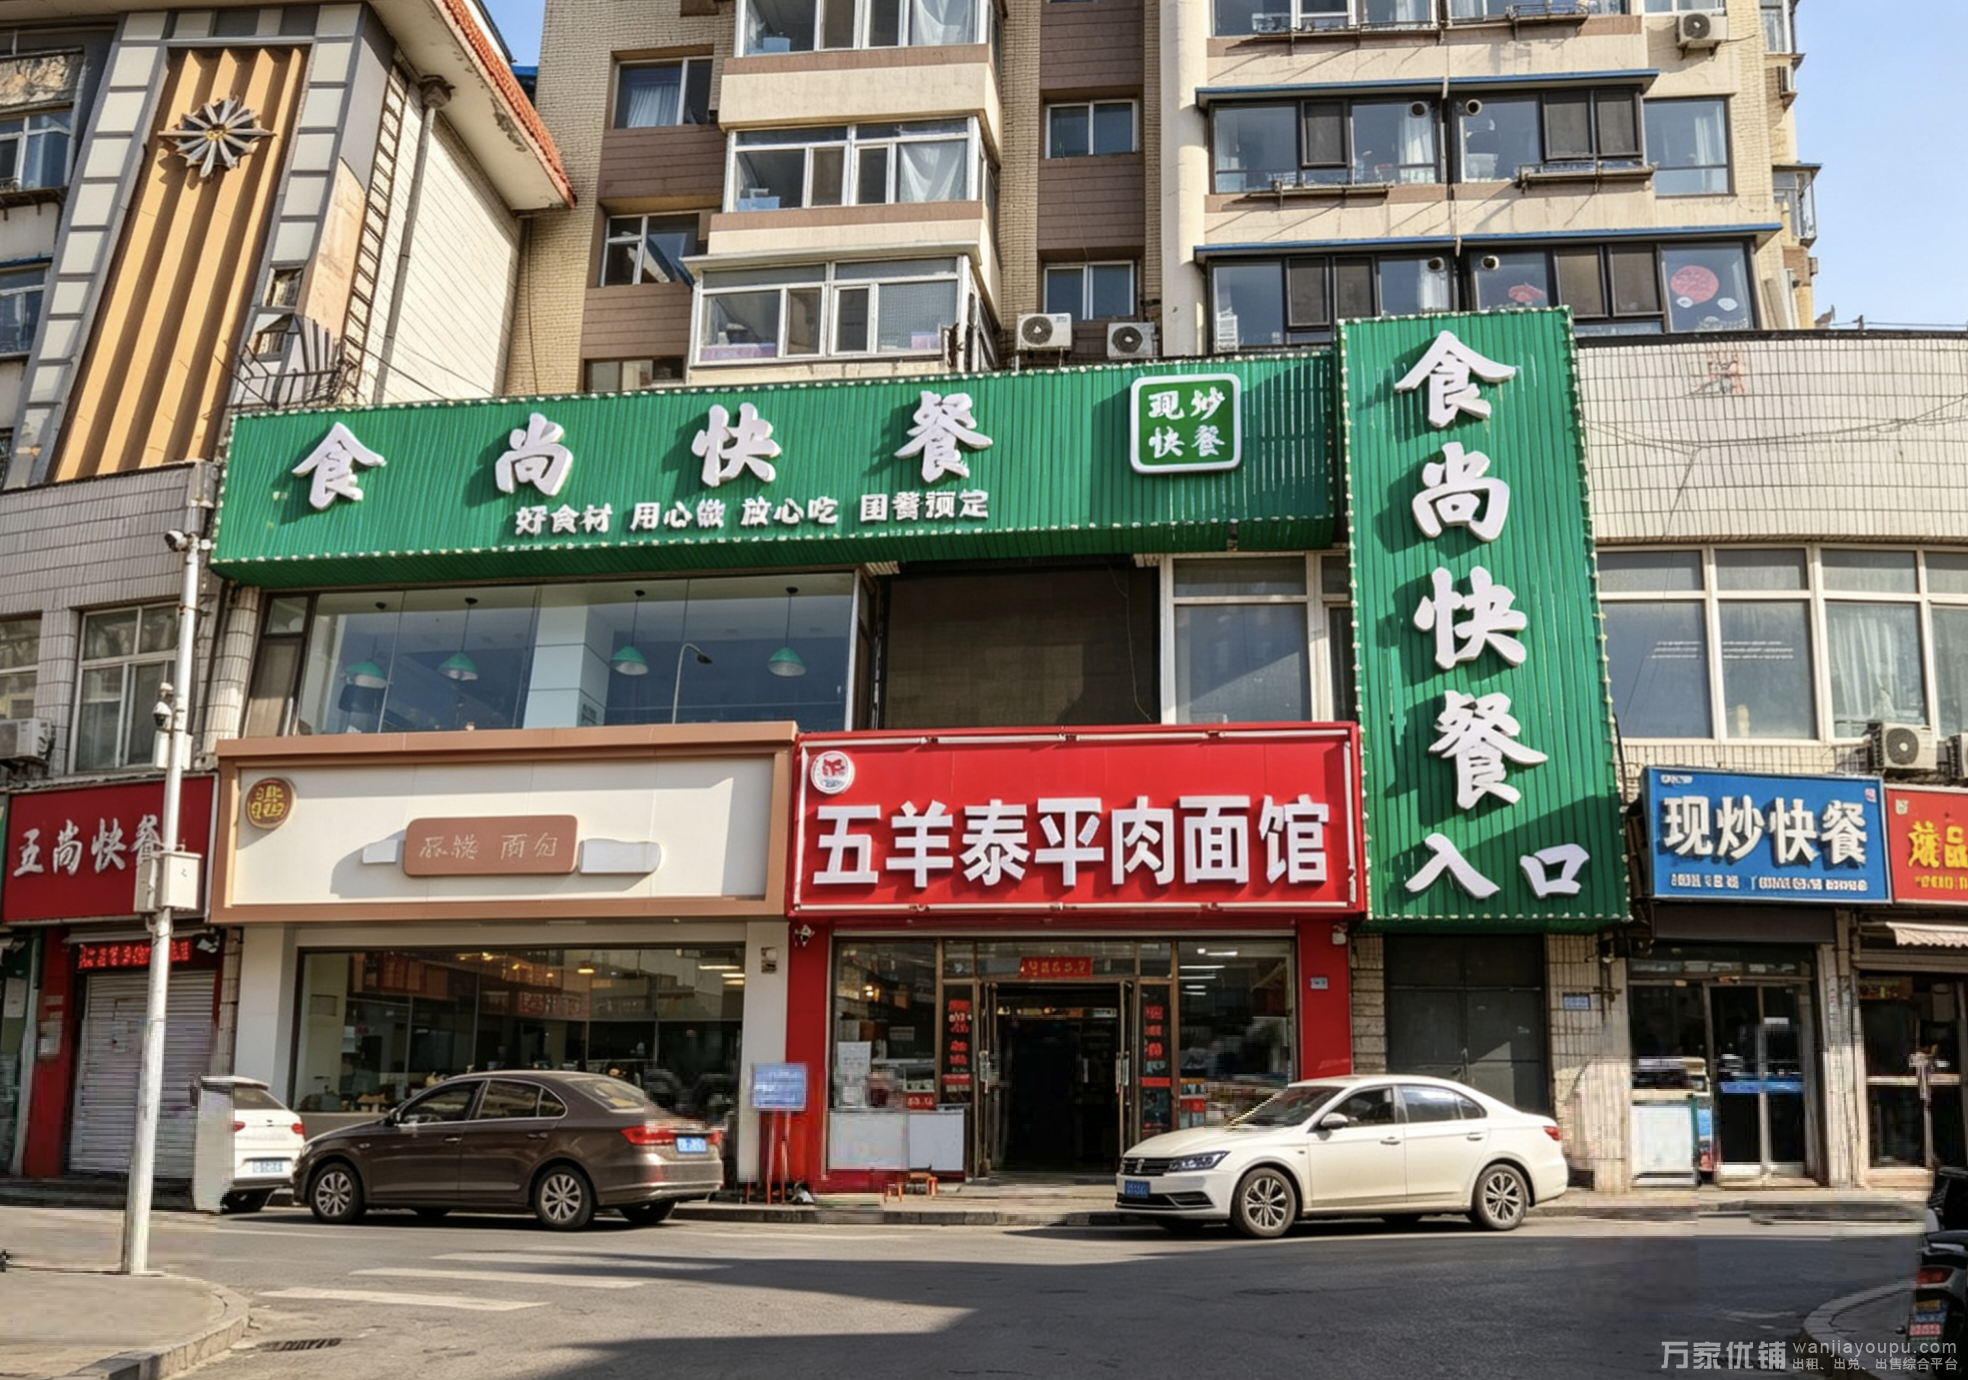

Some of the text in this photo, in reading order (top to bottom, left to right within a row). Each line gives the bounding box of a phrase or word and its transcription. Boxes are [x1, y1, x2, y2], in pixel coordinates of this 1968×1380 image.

[1148, 386, 1226, 421] 现炒
[292, 390, 994, 510] 食尚快餐
[1148, 424, 1226, 459] 快餐
[515, 503, 613, 536] 好食材
[740, 495, 839, 527] 放心吃
[1394, 329, 1549, 811] 食尚快餐
[812, 794, 1329, 889] 五羊泰平肉面馆
[1663, 795, 1868, 865] 现炒快餐
[1404, 832, 1590, 898] 入口
